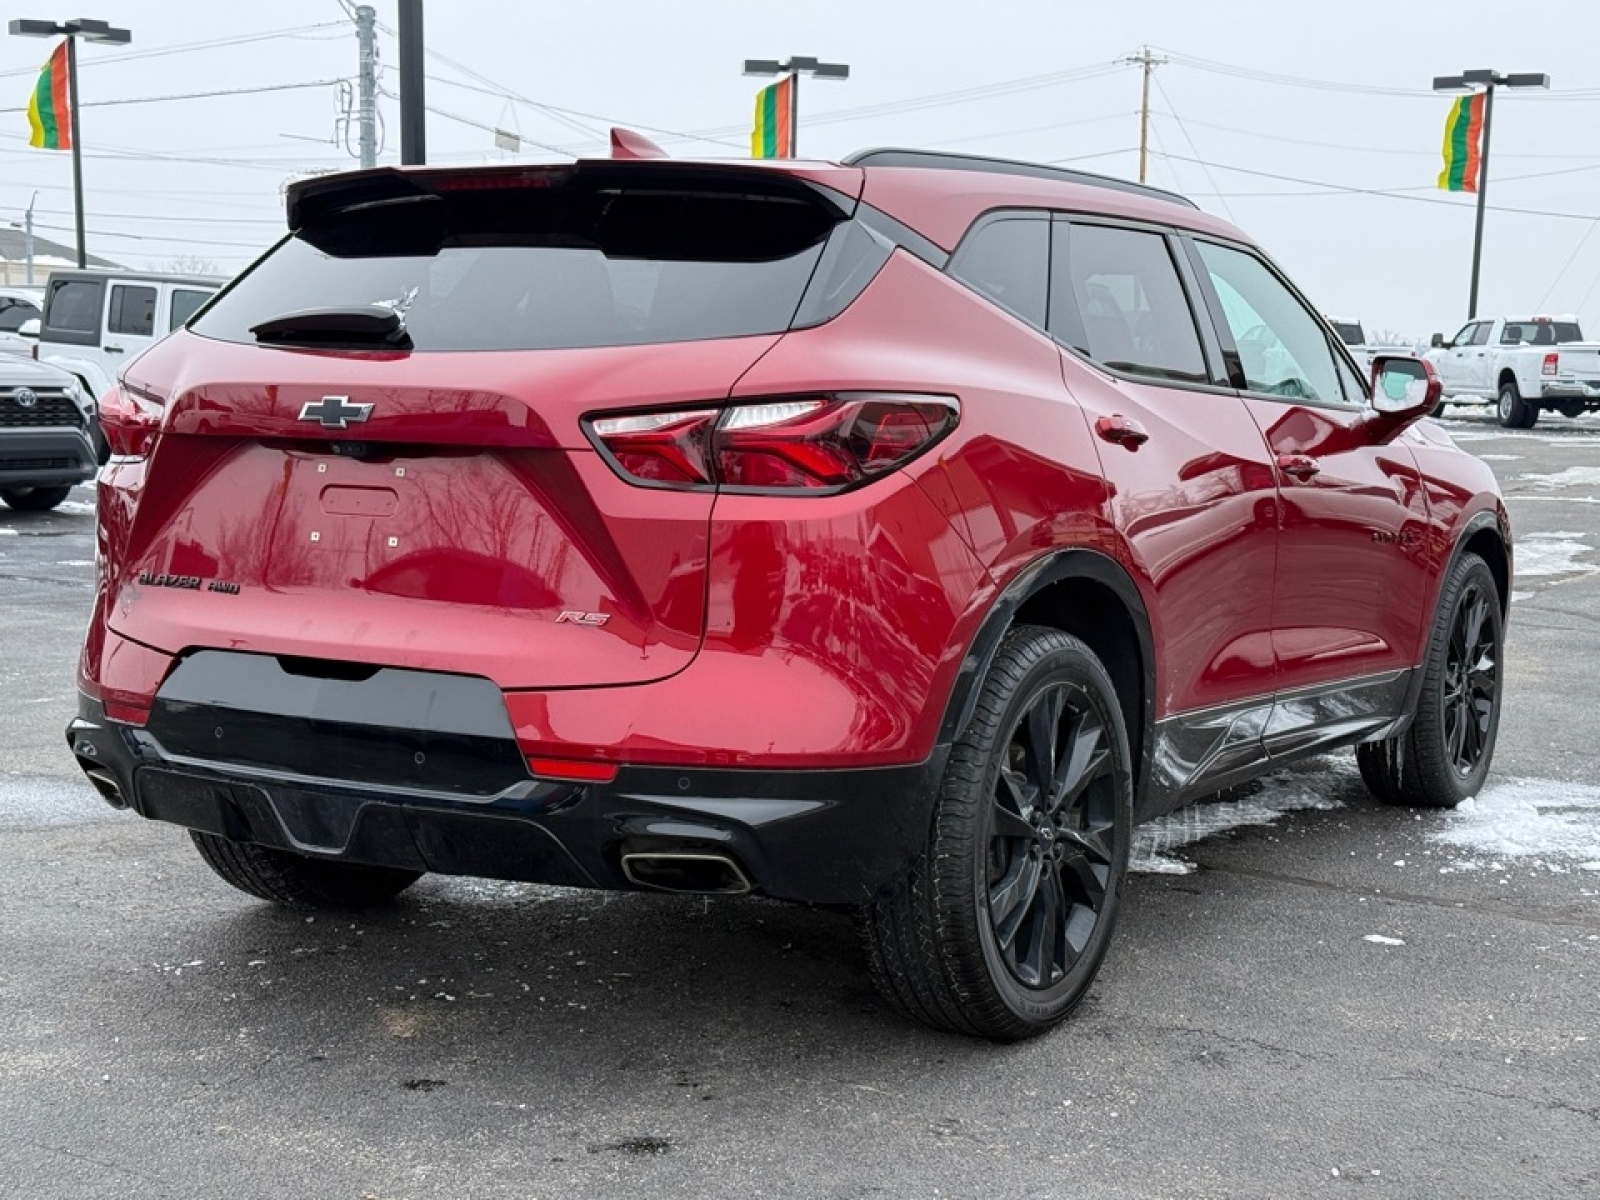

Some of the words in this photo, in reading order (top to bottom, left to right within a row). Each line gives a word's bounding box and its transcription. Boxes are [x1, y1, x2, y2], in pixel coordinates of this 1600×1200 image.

[138, 572, 202, 590] BLAZER
[208, 580, 240, 595] AWD
[555, 610, 611, 626] RS
